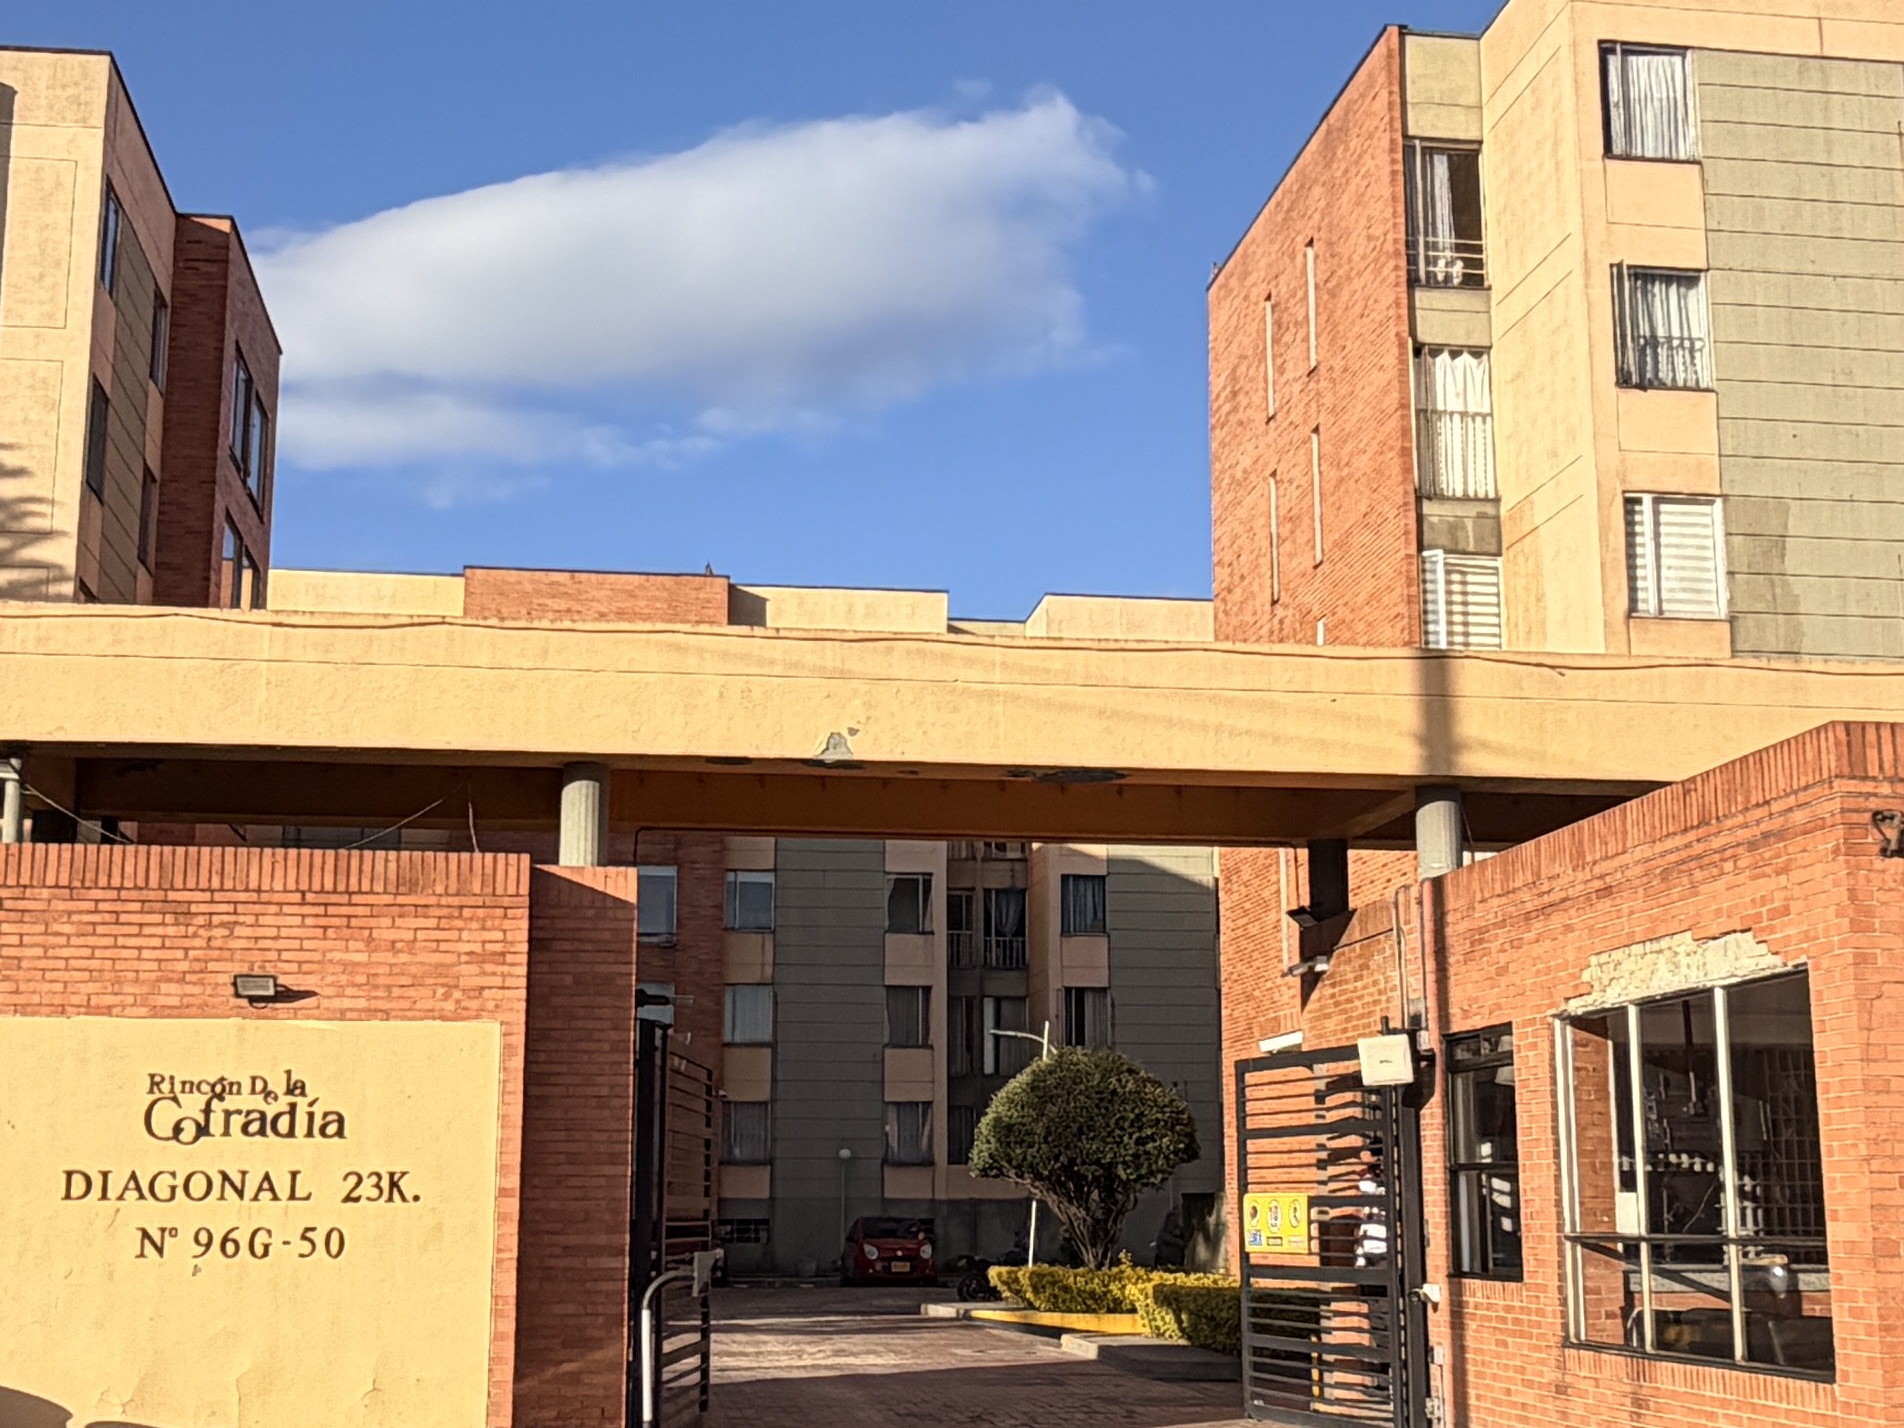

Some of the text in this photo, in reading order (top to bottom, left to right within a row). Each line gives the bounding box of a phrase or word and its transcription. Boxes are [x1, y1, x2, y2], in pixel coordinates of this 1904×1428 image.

[146, 1069, 308, 1105] Rincón De la
[144, 1093, 348, 1145] Cofradía
[61, 1169, 422, 1204] DIAGONAL 23K.
[191, 1226, 346, 1260] 96G-50
